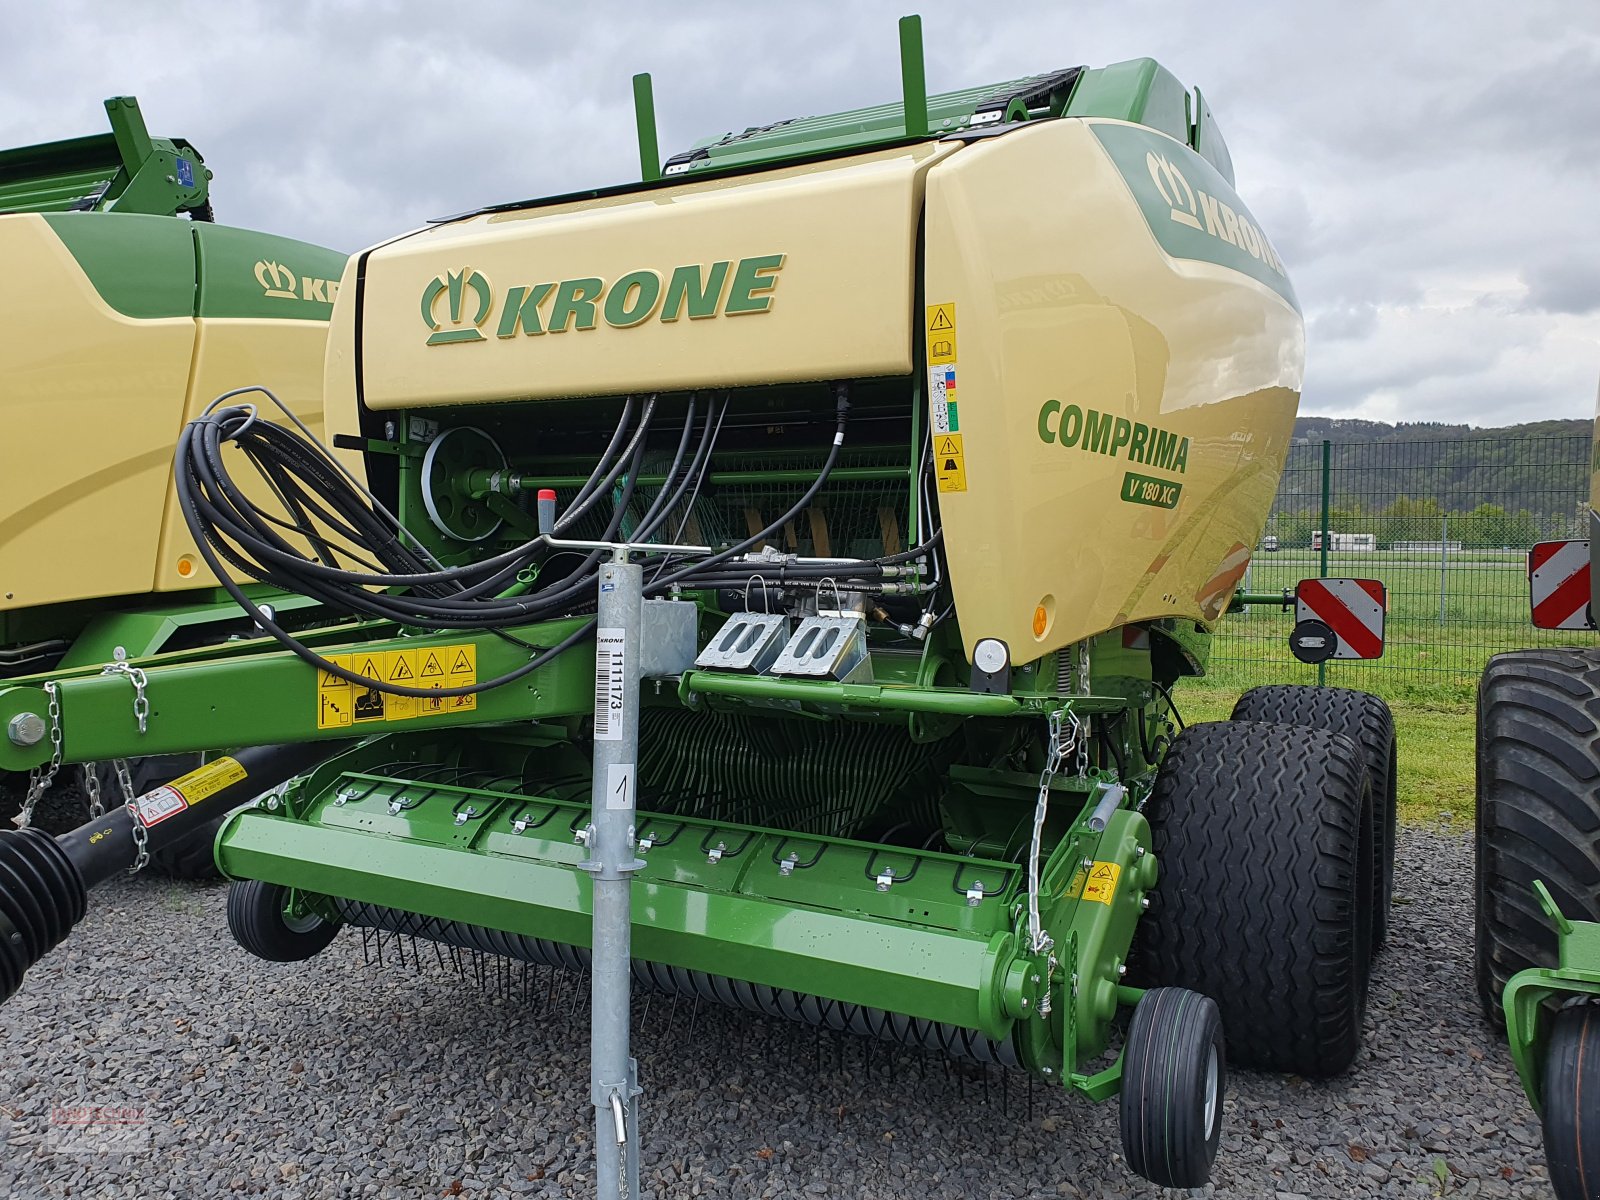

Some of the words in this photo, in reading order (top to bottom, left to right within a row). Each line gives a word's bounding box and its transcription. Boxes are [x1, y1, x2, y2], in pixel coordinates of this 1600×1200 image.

[496, 253, 788, 339] KRONE
[1037, 399, 1190, 474] COMPRIMA
[1129, 478, 1140, 497] V
[1141, 481, 1159, 501] 180
[1159, 485, 1177, 505] XC
[611, 651, 623, 709] 1111173
[616, 774, 627, 802] 1
